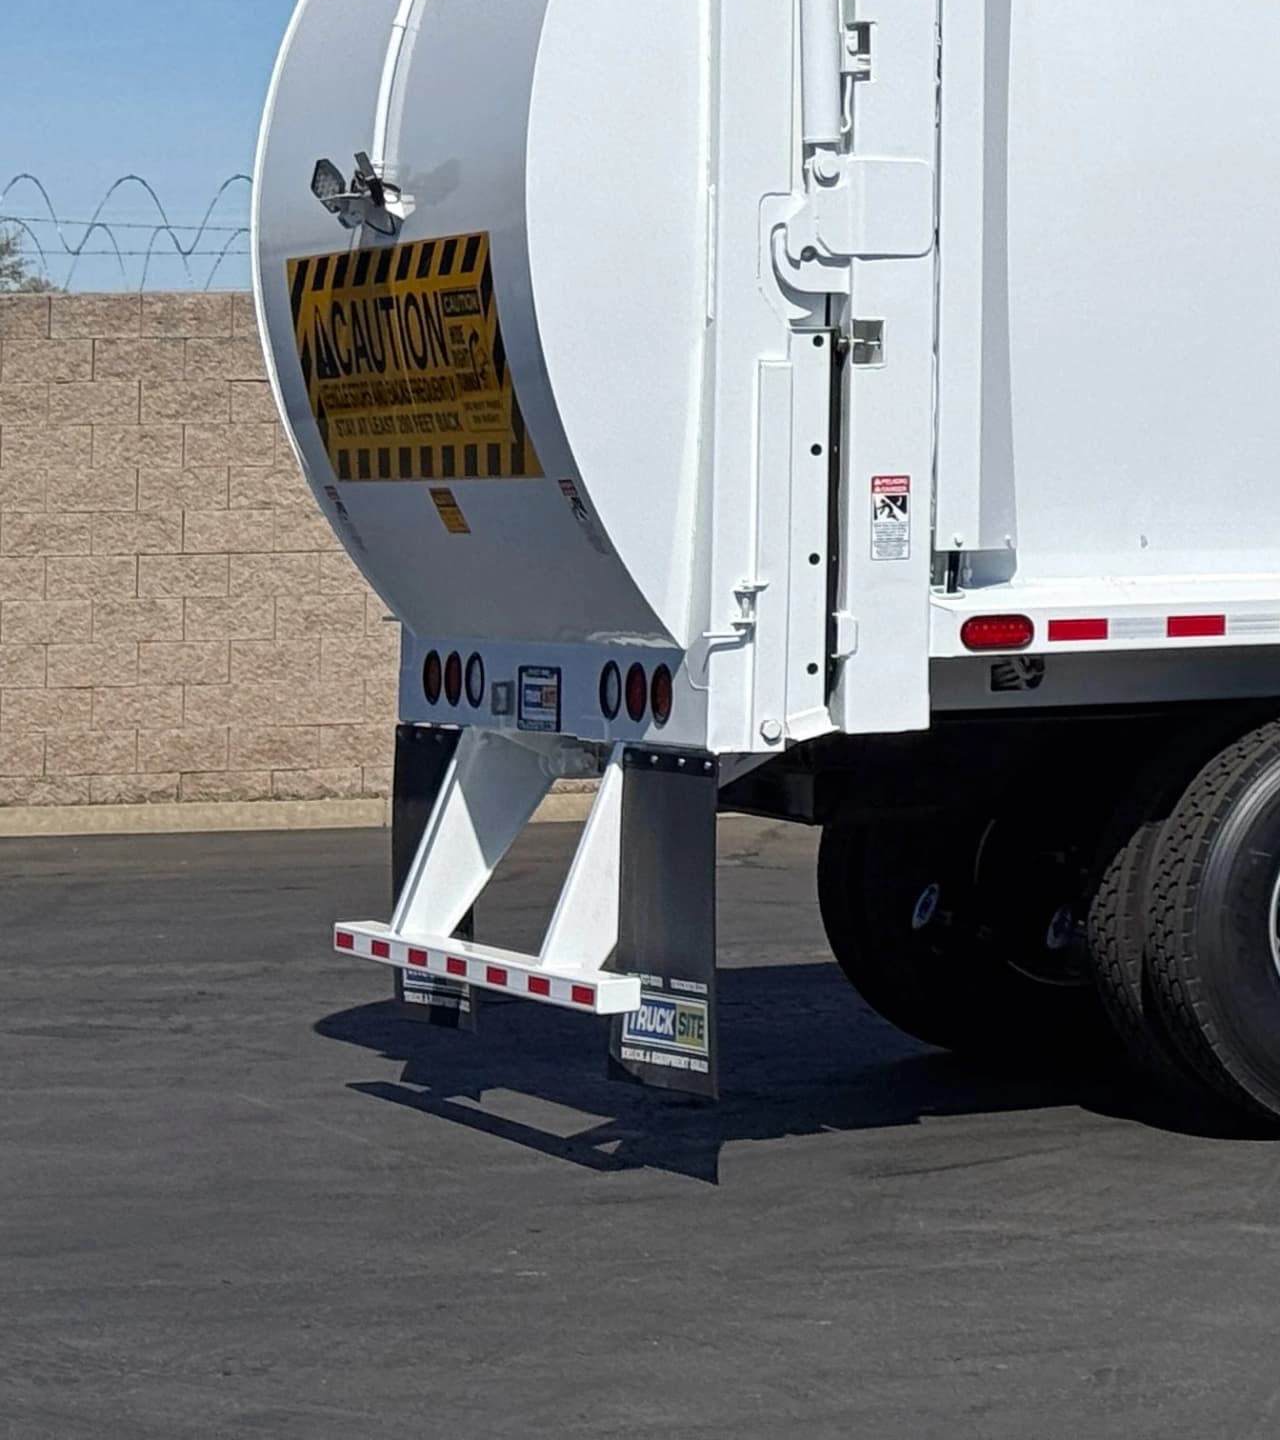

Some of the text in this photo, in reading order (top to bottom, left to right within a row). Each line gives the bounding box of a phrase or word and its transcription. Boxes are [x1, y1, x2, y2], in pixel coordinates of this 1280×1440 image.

[331, 291, 450, 378] CAUTION
[335, 418, 357, 438] STAY
[369, 415, 396, 436] LEAST
[678, 1011, 704, 1040] SITE
